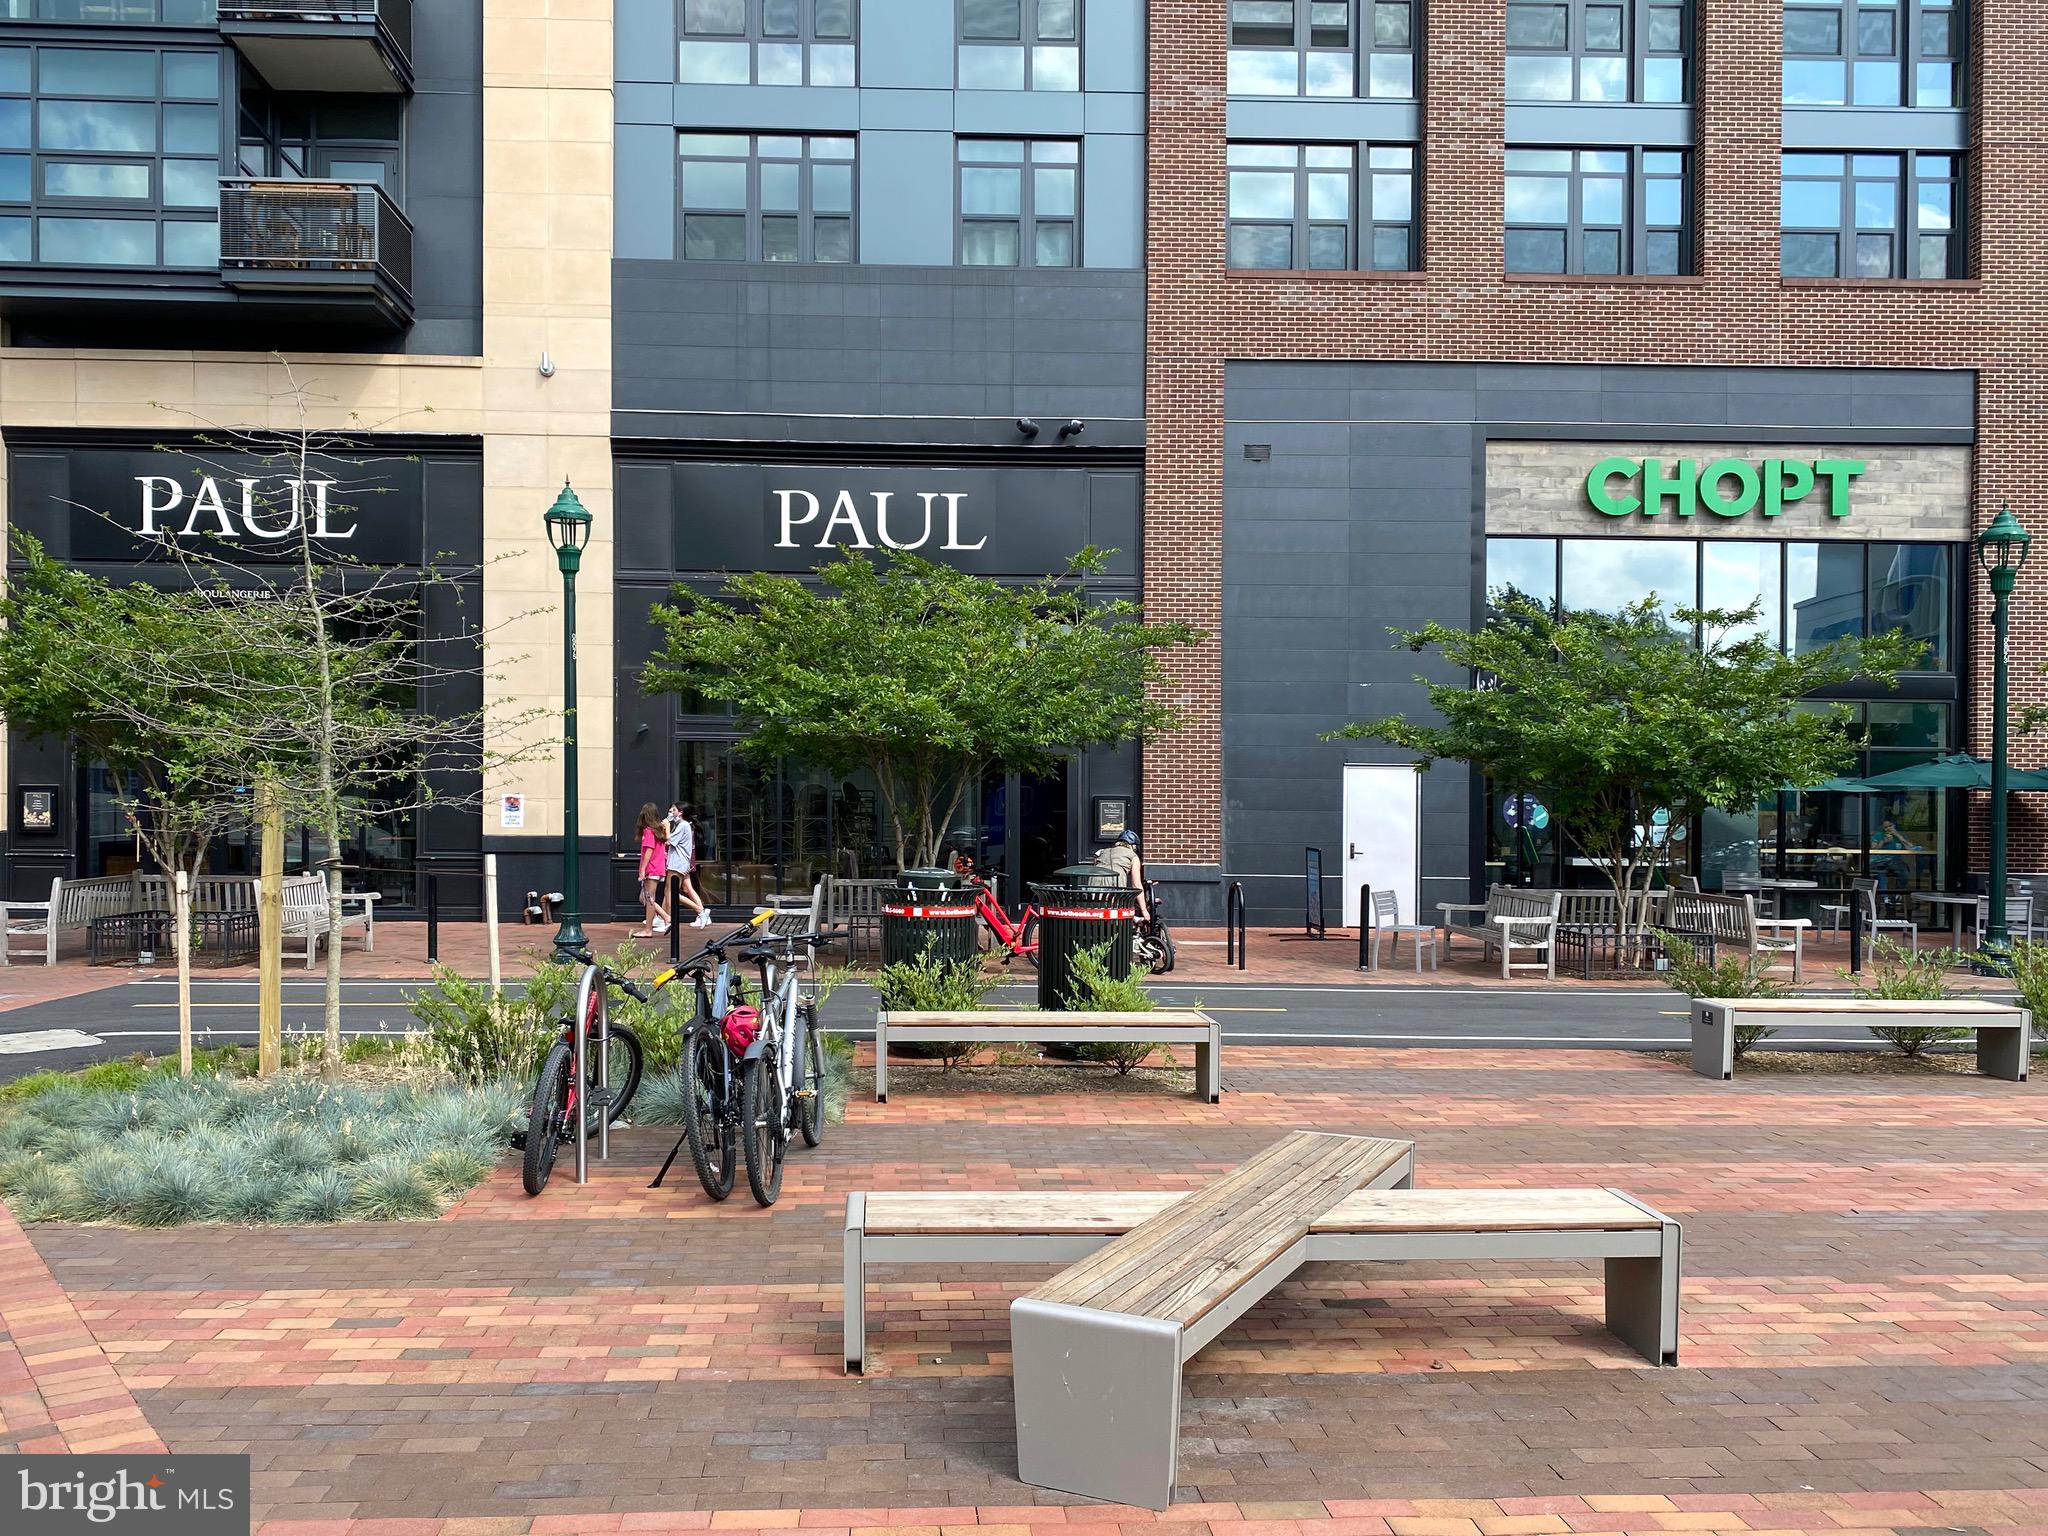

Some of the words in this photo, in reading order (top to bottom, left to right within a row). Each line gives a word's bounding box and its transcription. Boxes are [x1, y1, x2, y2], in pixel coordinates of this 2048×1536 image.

[134, 475, 358, 539] PAUL
[1586, 455, 1866, 517] CHOPT
[772, 489, 988, 551] PAUL
[197, 589, 271, 599] BOULANGERIE
